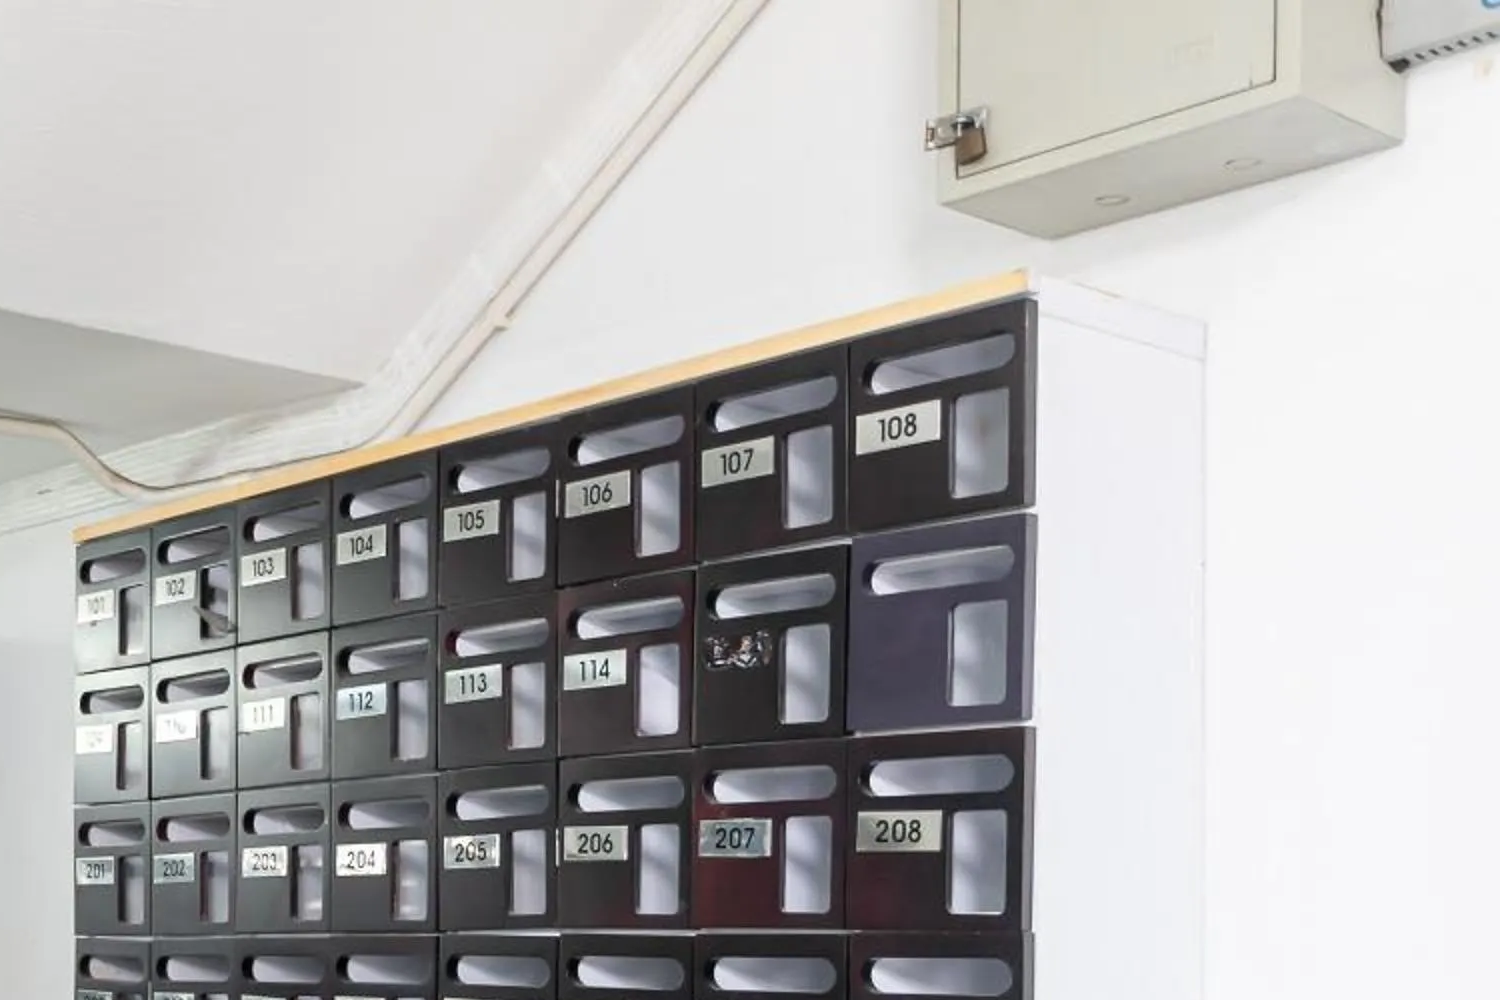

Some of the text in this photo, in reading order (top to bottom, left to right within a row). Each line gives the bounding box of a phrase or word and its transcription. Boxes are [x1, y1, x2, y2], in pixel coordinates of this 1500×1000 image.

[878, 413, 917, 442] 108
[720, 448, 754, 476] 107
[582, 484, 613, 507] 106
[457, 510, 485, 532] 105
[349, 535, 374, 557] 104
[252, 557, 275, 576] 103
[165, 578, 185, 597] 102
[579, 658, 610, 682] 114
[460, 674, 487, 695] 113
[349, 691, 373, 712] 112
[715, 827, 755, 850] 207
[874, 819, 921, 843] 208
[455, 841, 487, 863] 205
[577, 833, 613, 855] 206
[86, 862, 105, 879] 201
[162, 860, 186, 876] 202
[252, 853, 276, 871] 203
[347, 850, 376, 870] 204
